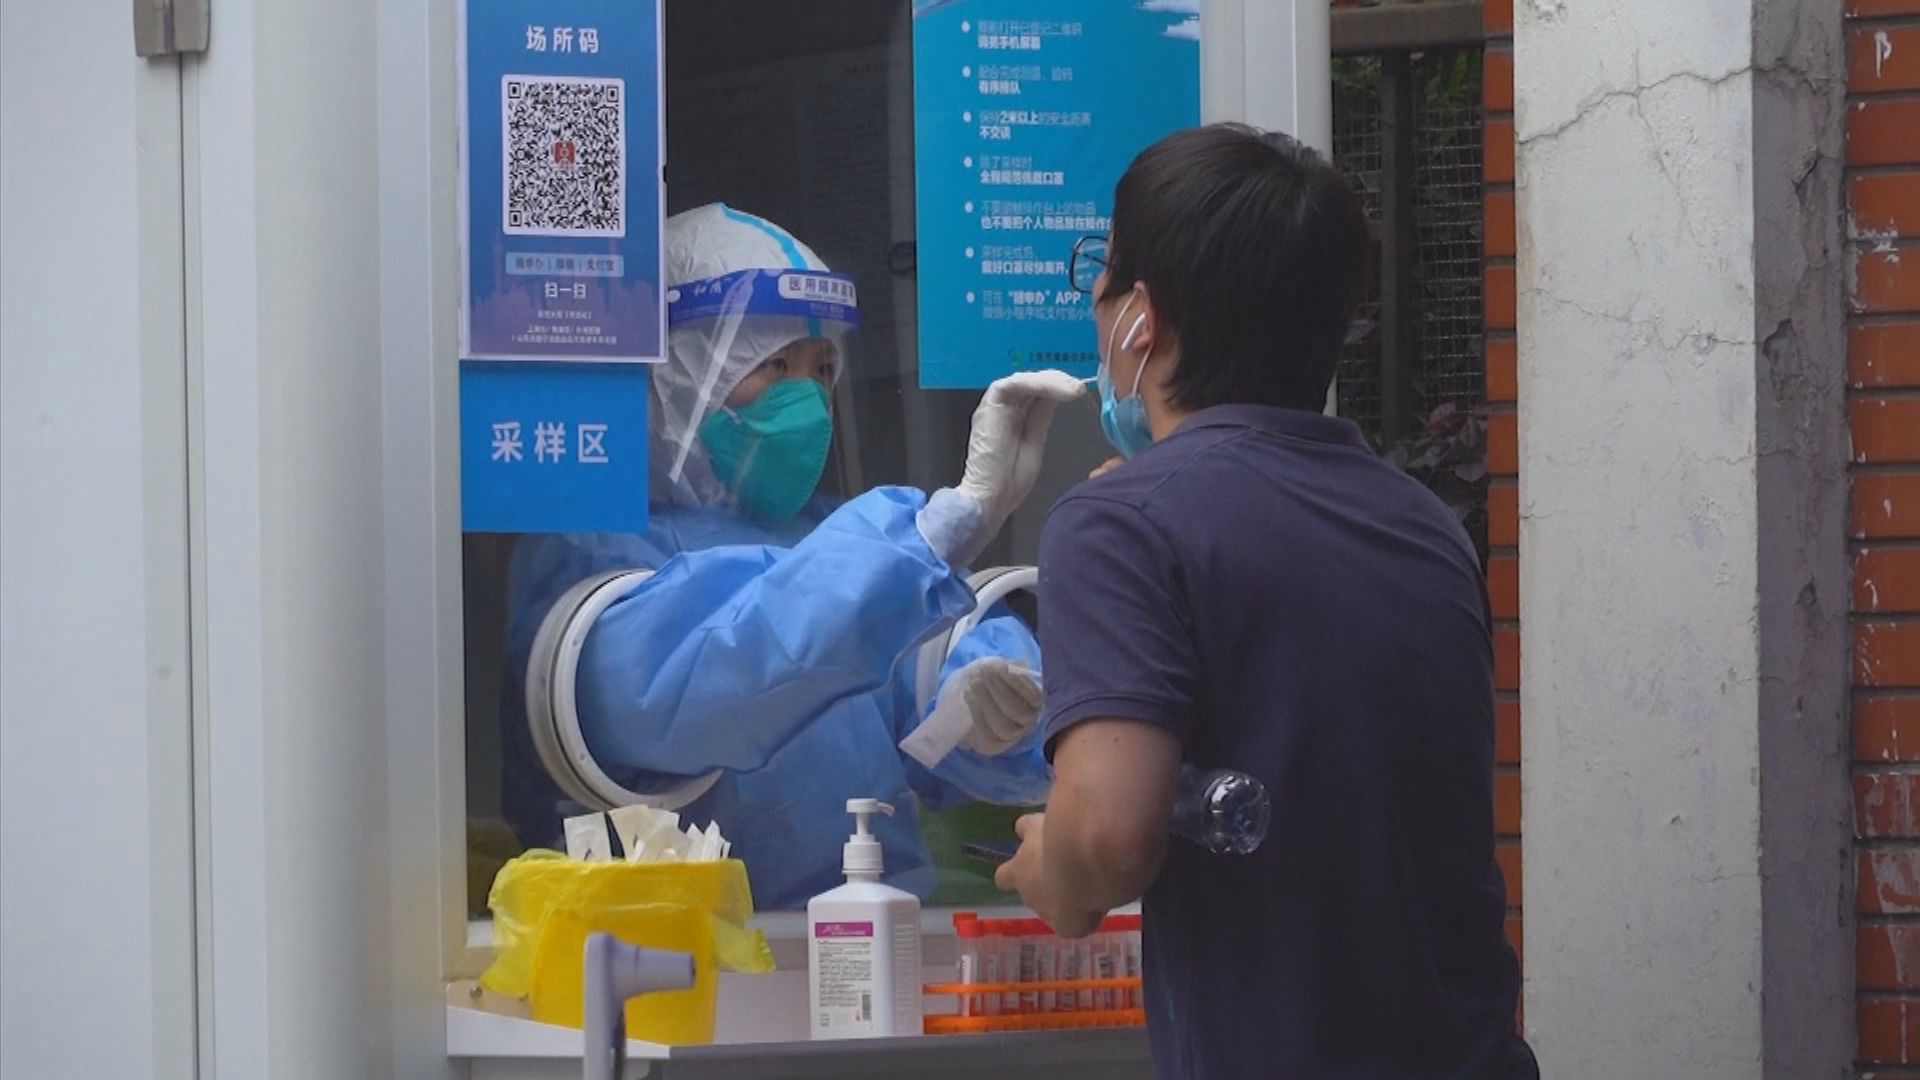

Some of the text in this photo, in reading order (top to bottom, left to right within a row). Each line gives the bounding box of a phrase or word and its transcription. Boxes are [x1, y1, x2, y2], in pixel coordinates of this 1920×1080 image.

[526, 25, 600, 53] 场所码
[979, 125, 1012, 140] 不交谈
[544, 281, 587, 299] 扫一扫
[491, 421, 609, 464] 采样区
